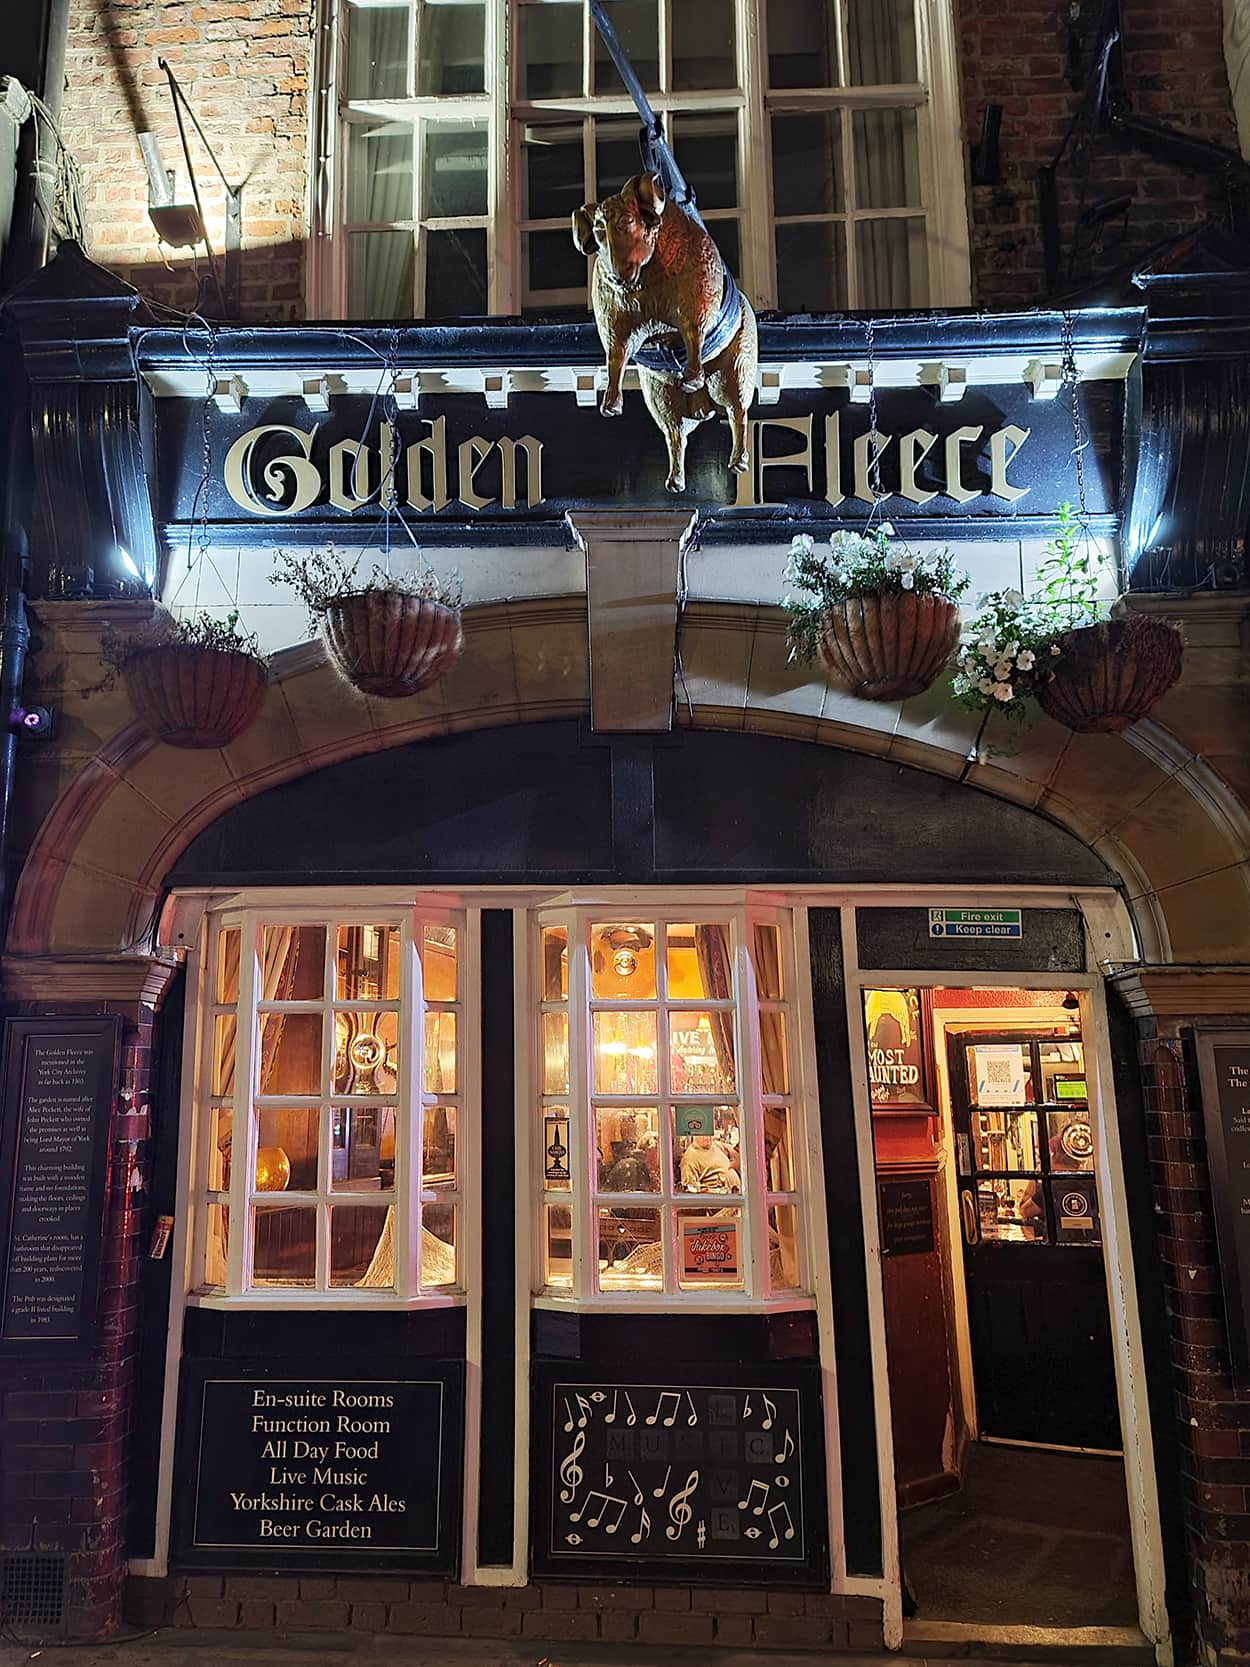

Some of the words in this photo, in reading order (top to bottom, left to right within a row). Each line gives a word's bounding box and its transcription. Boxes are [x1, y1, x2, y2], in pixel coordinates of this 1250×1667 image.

[223, 415, 546, 516] Golden
[719, 409, 1032, 511] Fleece
[961, 912, 981, 921] Fire
[984, 912, 1004, 921] exit
[955, 925, 984, 935] Keep
[985, 925, 1012, 934] clear
[672, 1031, 701, 1045] IVE
[868, 1049, 905, 1065] MOST
[869, 1065, 919, 1084] AUNTED
[1228, 1066, 1249, 1075] The
[1227, 1078, 1248, 1088] The
[252, 1389, 327, 1408] En-suite
[332, 1390, 394, 1408] Rooms
[251, 1415, 330, 1433] Function
[337, 1416, 391, 1434] Room
[260, 1440, 287, 1459] All
[293, 1441, 329, 1464] Day
[334, 1442, 379, 1459] Food
[270, 1467, 307, 1485] Live
[312, 1467, 368, 1486] Music
[230, 1492, 314, 1512] Yorkshire
[319, 1493, 364, 1512] Cask
[367, 1494, 406, 1513] Ales
[259, 1519, 300, 1538] Beer
[305, 1520, 372, 1539] Garden
